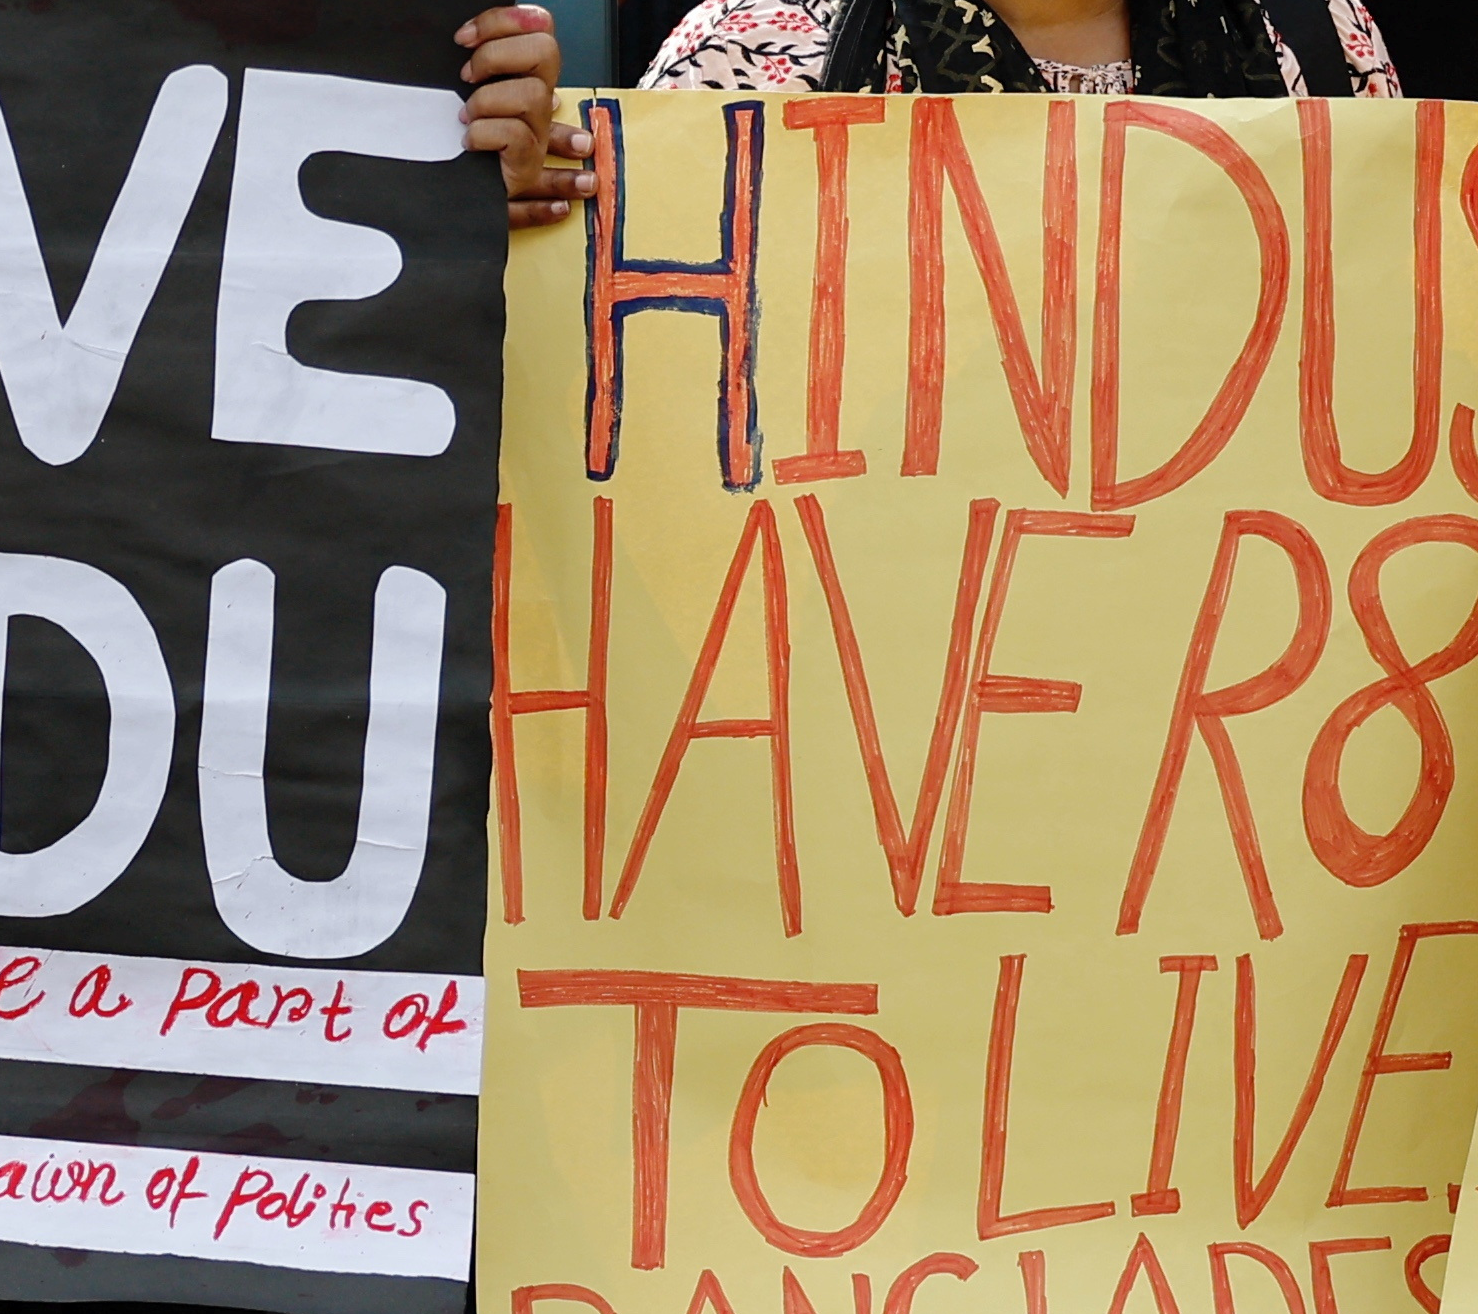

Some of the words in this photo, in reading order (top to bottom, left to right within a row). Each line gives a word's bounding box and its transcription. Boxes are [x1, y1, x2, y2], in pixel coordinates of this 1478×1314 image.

[492, 494, 1136, 937] HAVE
[68, 964, 134, 1018] a
[382, 980, 468, 1053] of
[145, 1155, 208, 1229] of
[517, 968, 914, 1270] TO
